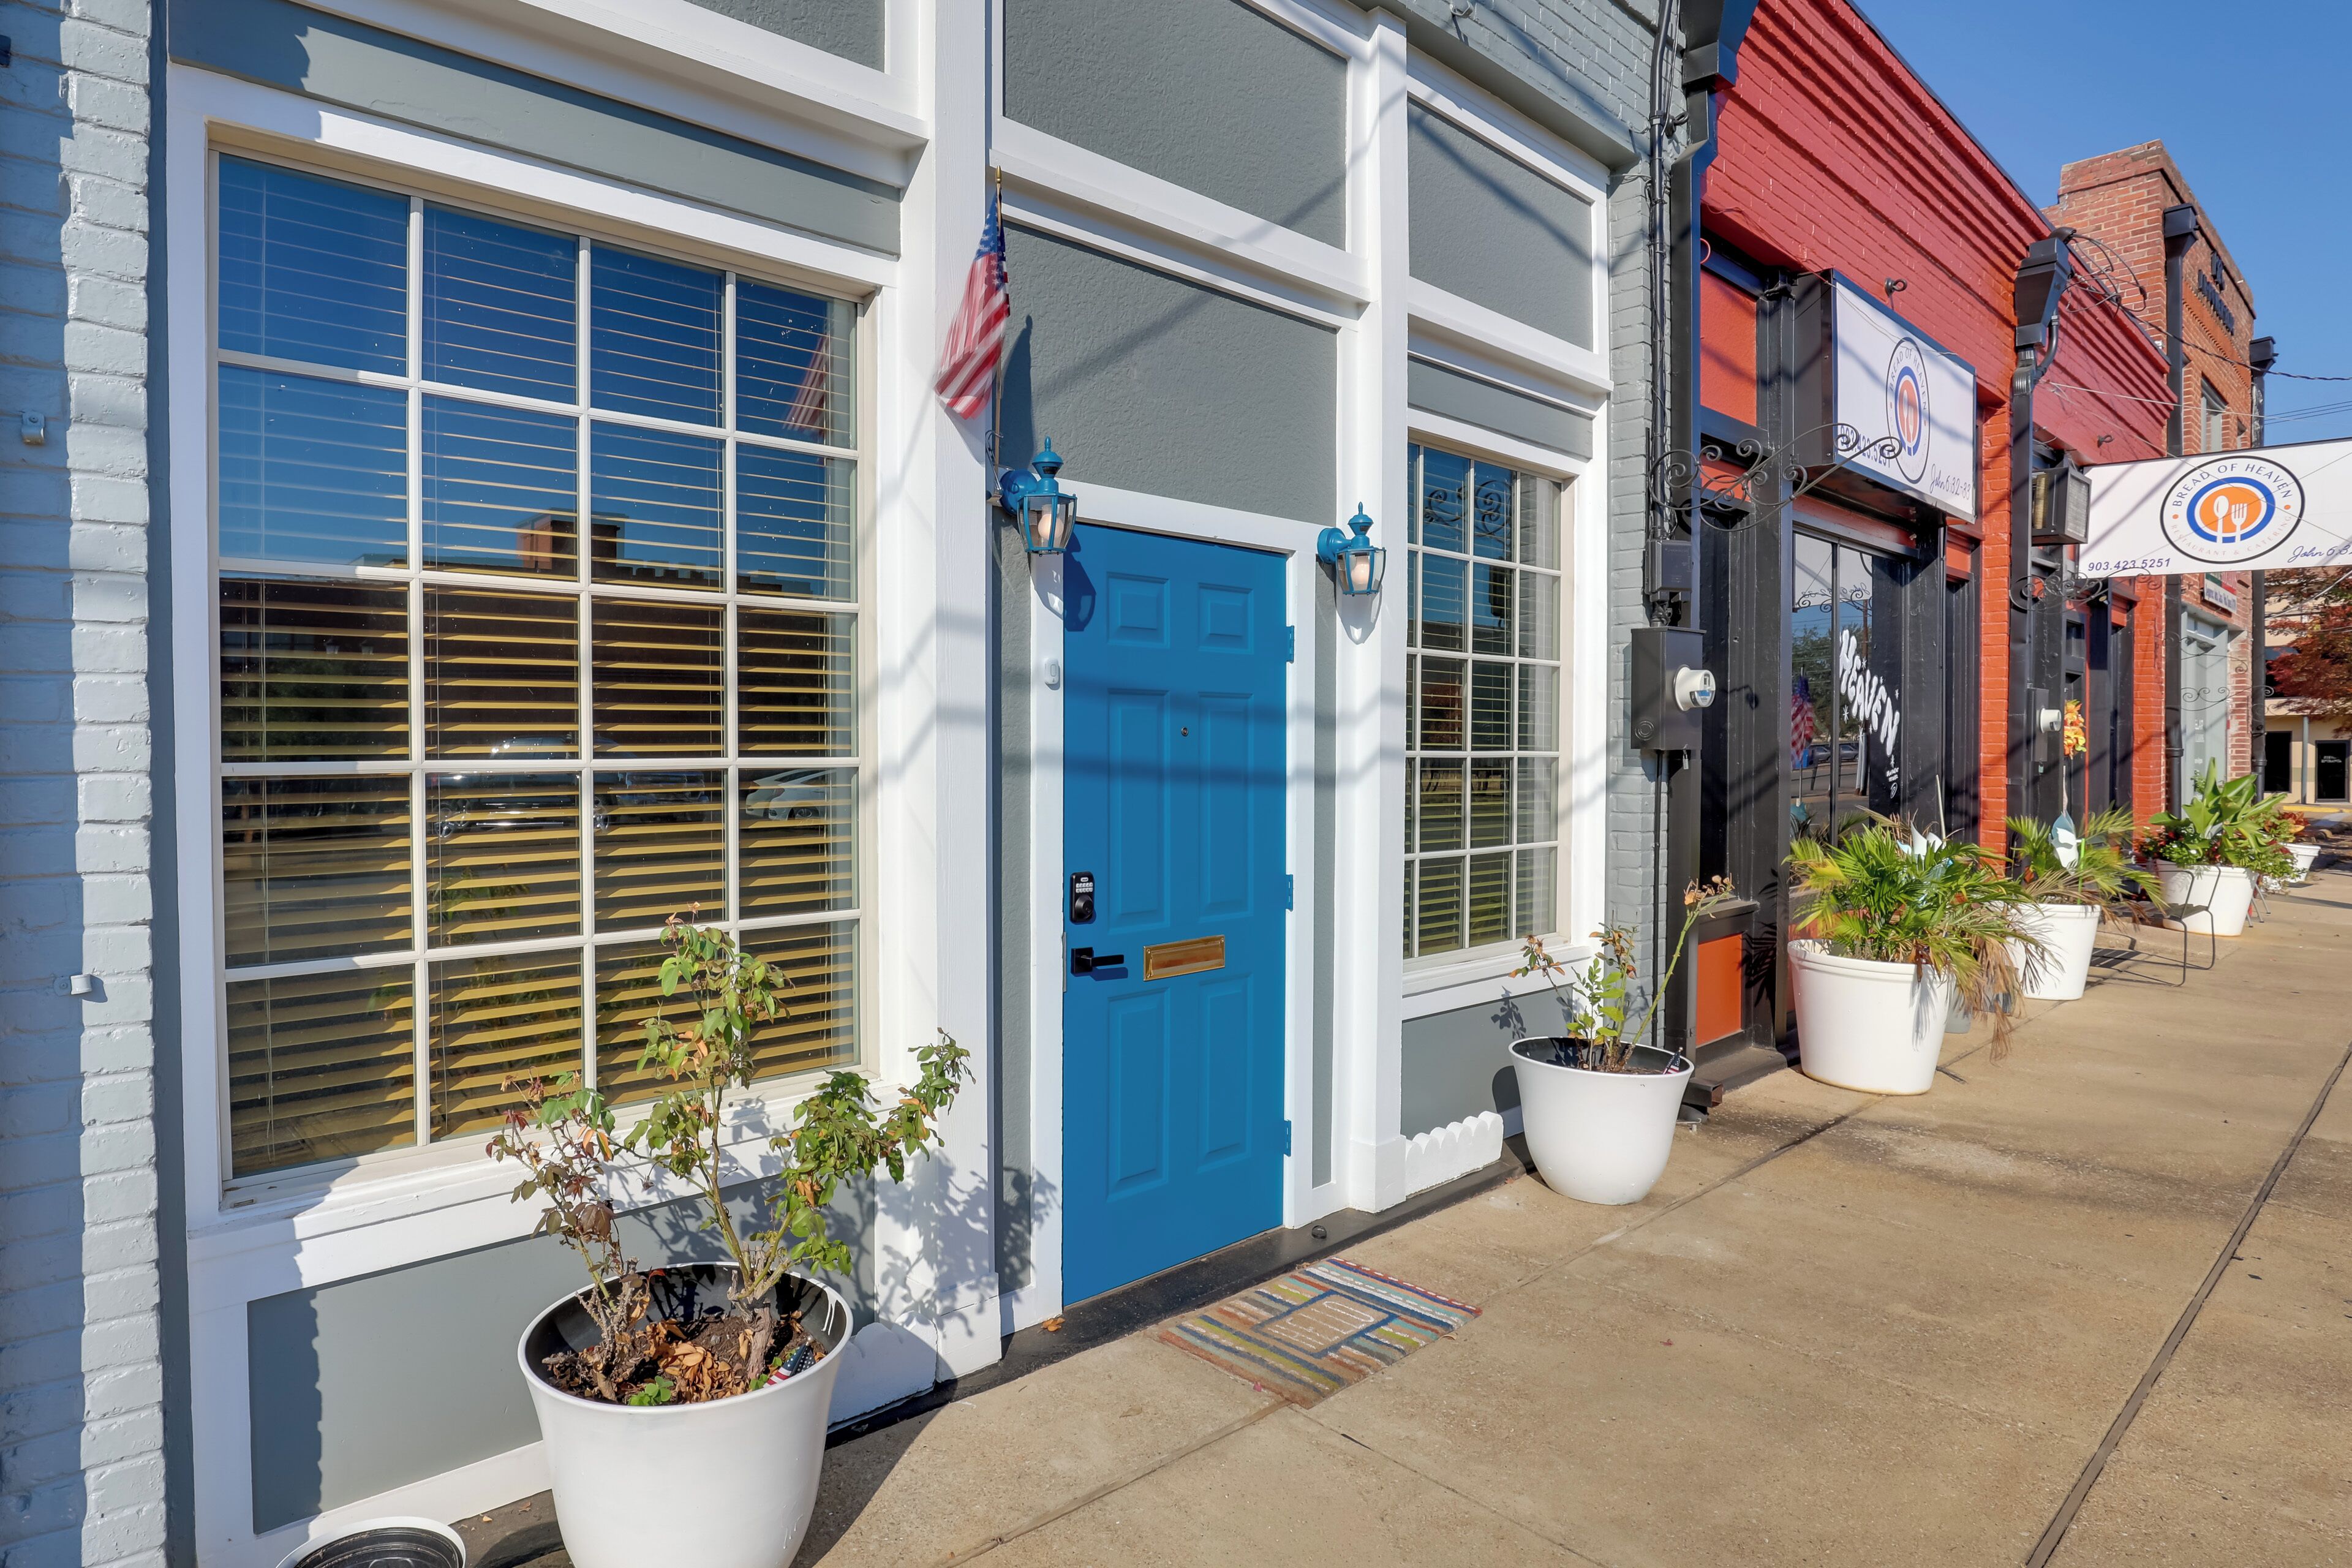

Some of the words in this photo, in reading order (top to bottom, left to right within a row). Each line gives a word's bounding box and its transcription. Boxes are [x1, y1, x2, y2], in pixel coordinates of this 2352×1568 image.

[1890, 351, 1903, 391] BREAD
[1905, 347, 1912, 360] OF
[1913, 355, 1927, 410] HEAVEN
[1929, 463, 1945, 494] John
[2172, 471, 2210, 507] BREAD
[2217, 463, 2238, 473] OF
[2244, 464, 2293, 499] HEAVEN
[2170, 524, 2226, 556] RESTAURANT
[2247, 516, 2292, 552] CATERING
[2287, 546, 2324, 563] John
[2326, 545, 2352, 556] 6:3
[2088, 558, 2170, 571] 903.423.5251
[1267, 1300, 1374, 1350] HELLO
